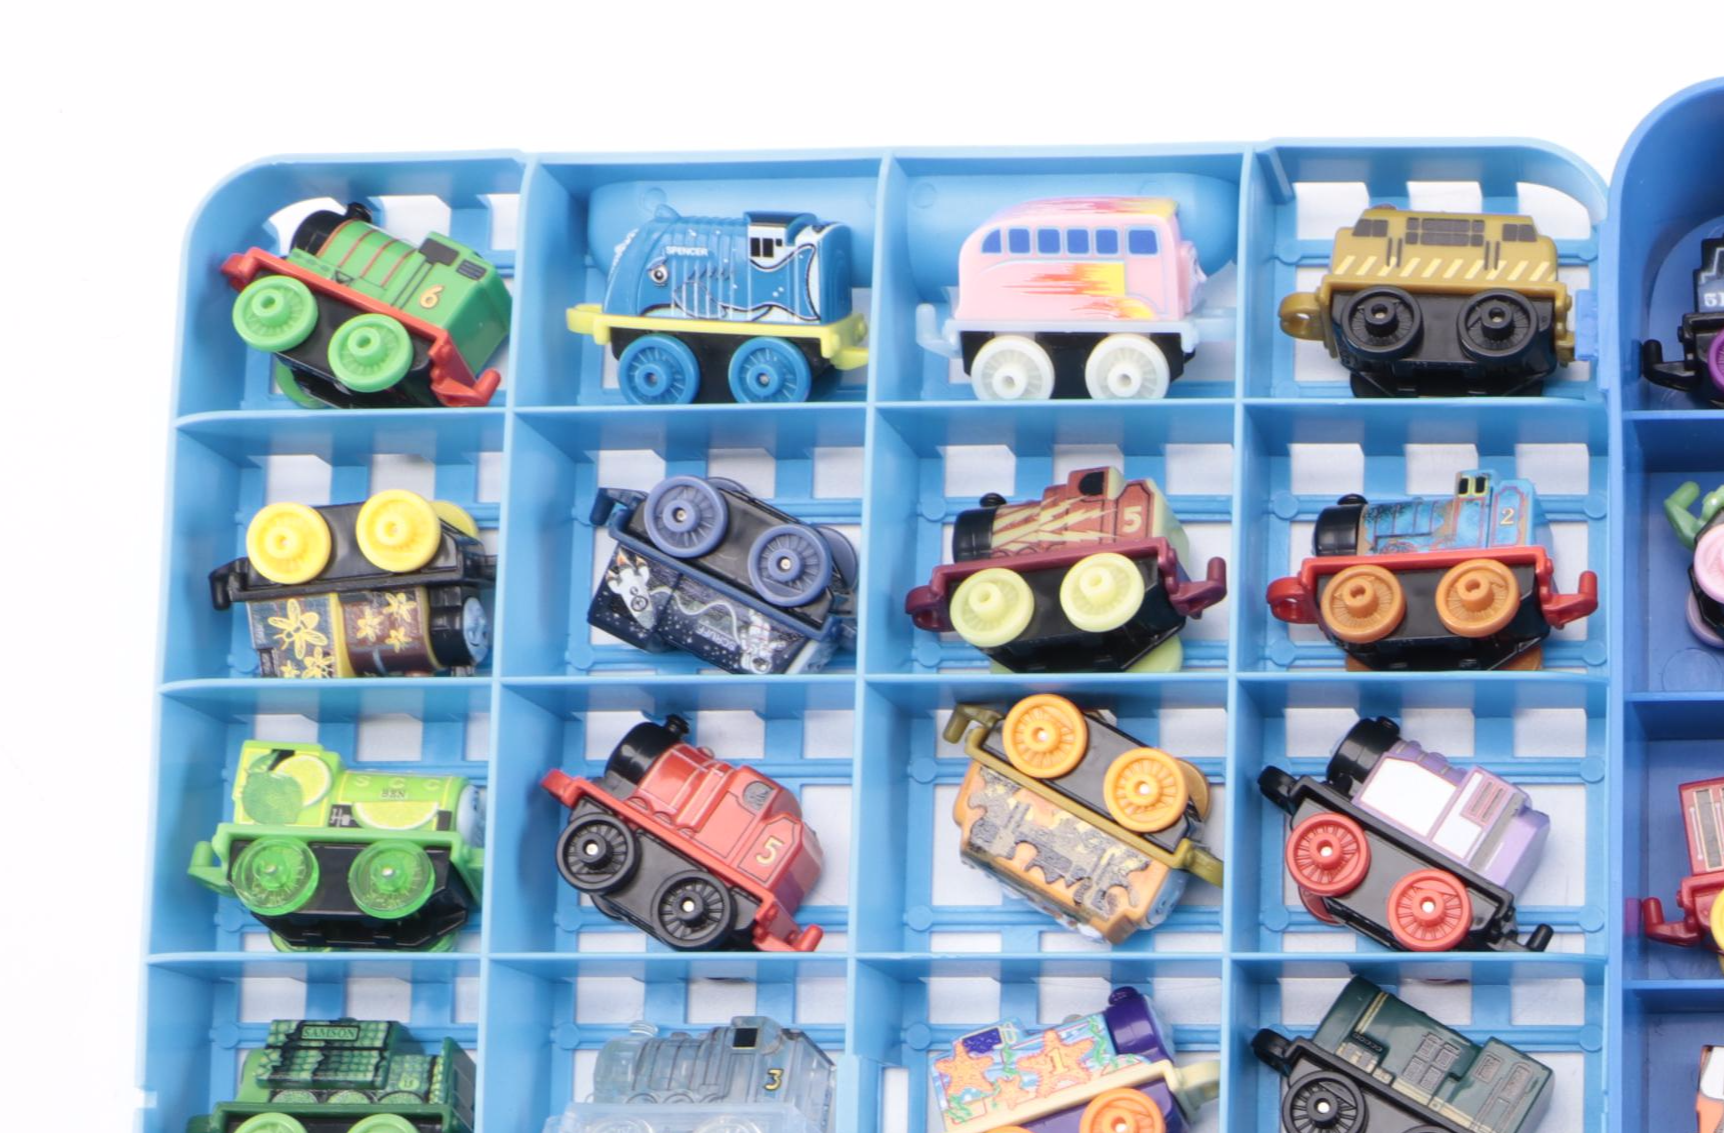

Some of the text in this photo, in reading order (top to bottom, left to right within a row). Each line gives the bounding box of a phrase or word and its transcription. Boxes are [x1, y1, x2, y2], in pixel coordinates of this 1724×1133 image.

[665, 245, 708, 256] SPENCER
[419, 284, 445, 309] 6
[1122, 505, 1142, 533] 5
[1500, 507, 1515, 526] 2
[694, 626, 740, 651] SCRUFF
[355, 775, 371, 787] S
[756, 834, 785, 866] 5
[301, 1025, 357, 1039] SAMSON
[1049, 1046, 1070, 1076] 1
[763, 1067, 785, 1091] 3
